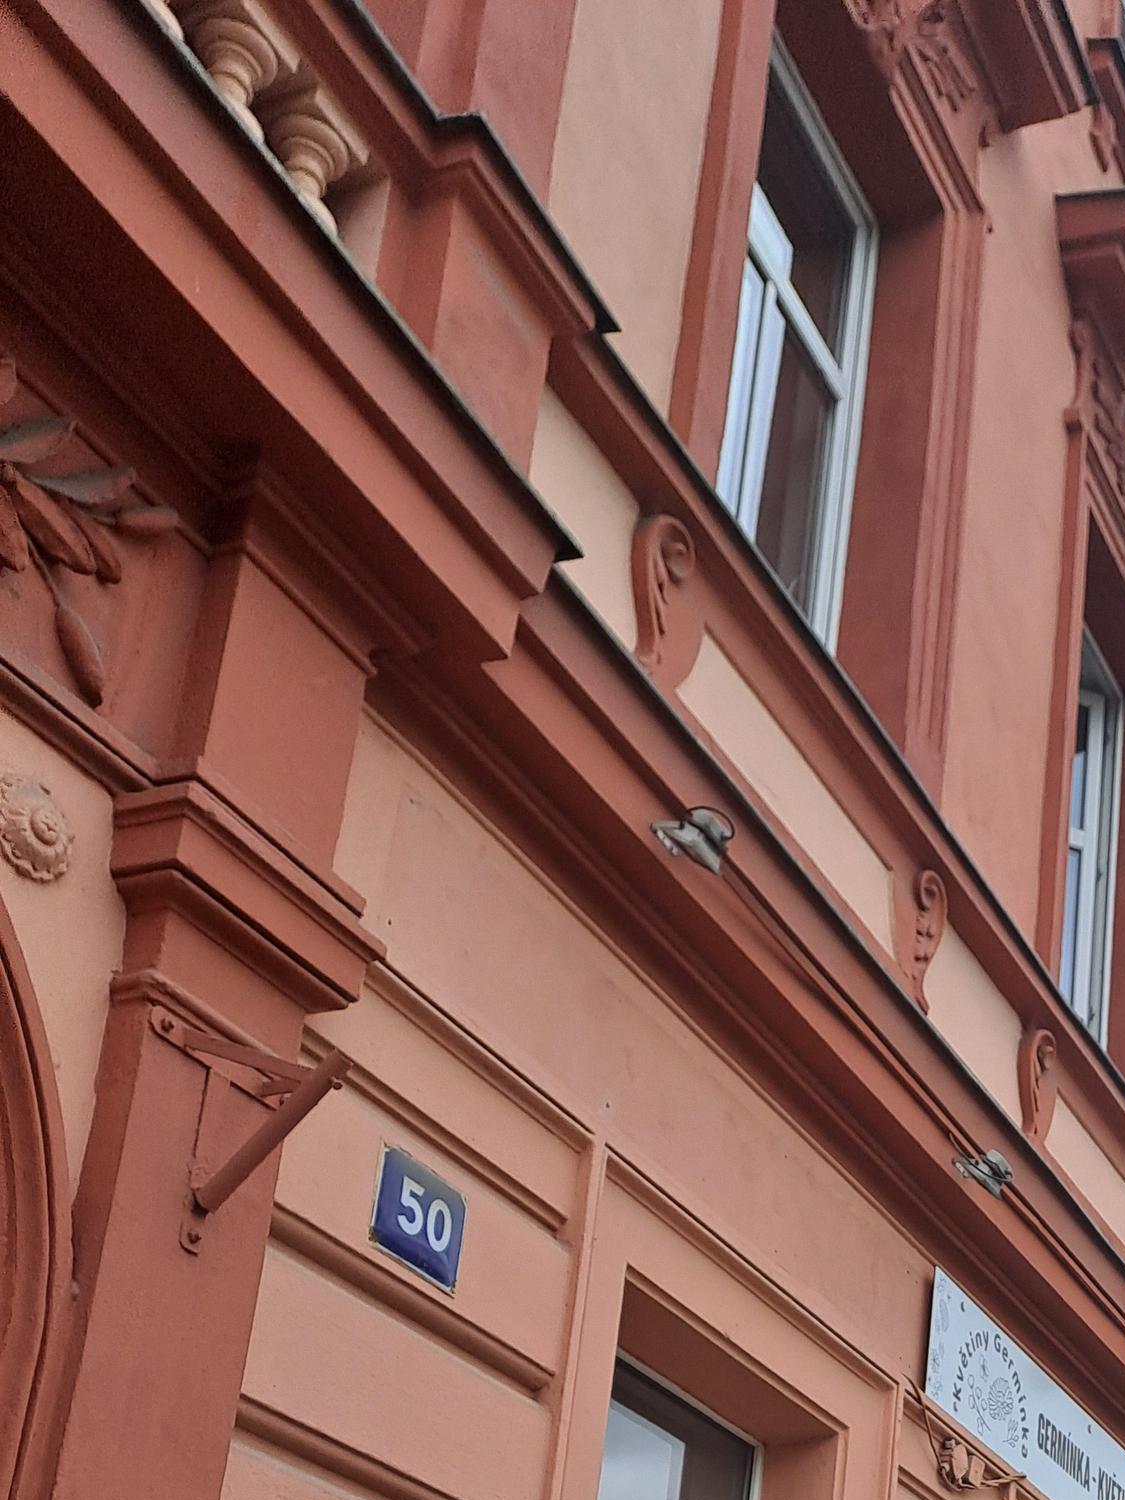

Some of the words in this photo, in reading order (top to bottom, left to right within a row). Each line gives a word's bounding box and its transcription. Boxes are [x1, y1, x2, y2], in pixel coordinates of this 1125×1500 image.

[397, 1176, 452, 1253] 50
[953, 1329, 990, 1402] Květiny
[993, 1333, 1028, 1458] Germínka
[1036, 1413, 1091, 1493] GERMÍNKA
